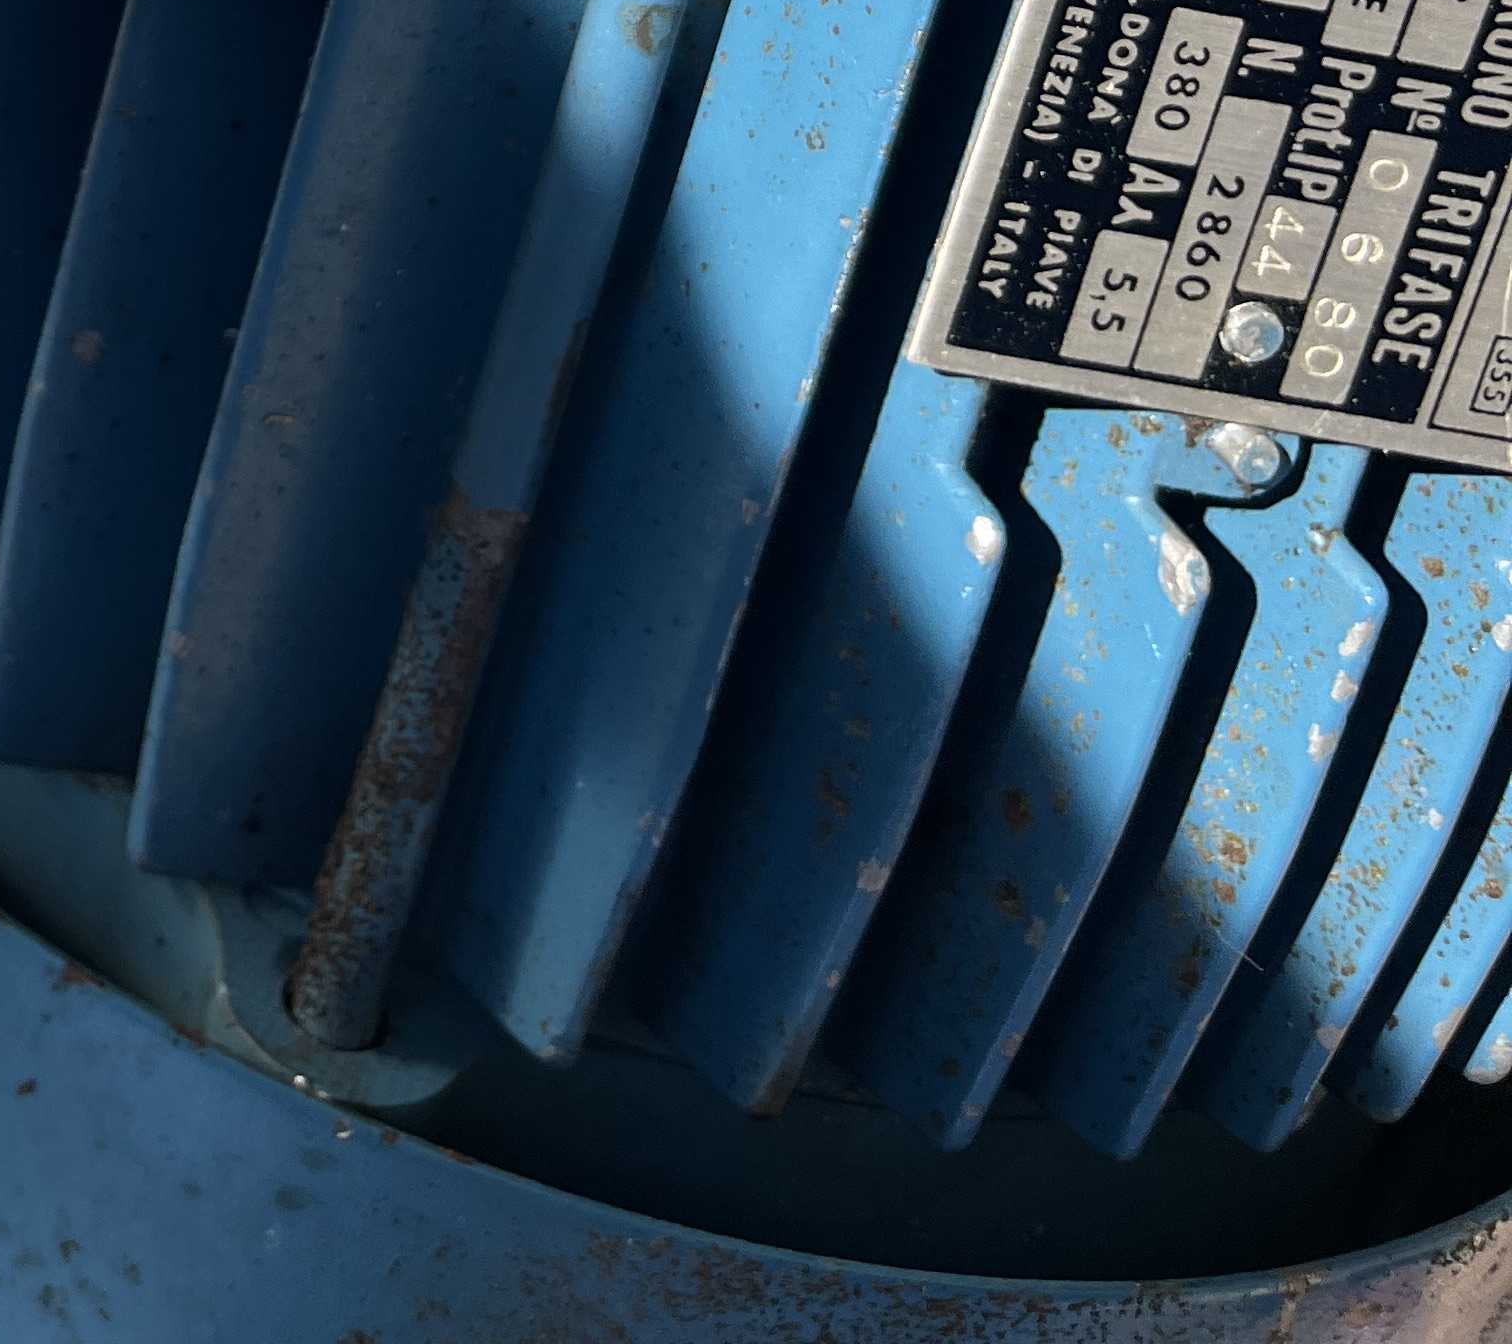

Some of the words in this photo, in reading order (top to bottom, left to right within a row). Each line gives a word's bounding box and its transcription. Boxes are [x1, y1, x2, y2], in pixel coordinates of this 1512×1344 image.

[1154, 40, 1210, 131] 380
[1237, 37, 1304, 77] N.
[1066, 148, 1102, 182] DI
[978, 201, 1032, 300] ITALY
[1026, 208, 1082, 310] PIAVE
[1176, 174, 1246, 303] 2860
[1251, 206, 1305, 278] 44
[1370, 169, 1496, 370] TRIFASE
[1090, 266, 1139, 334] 5,5
